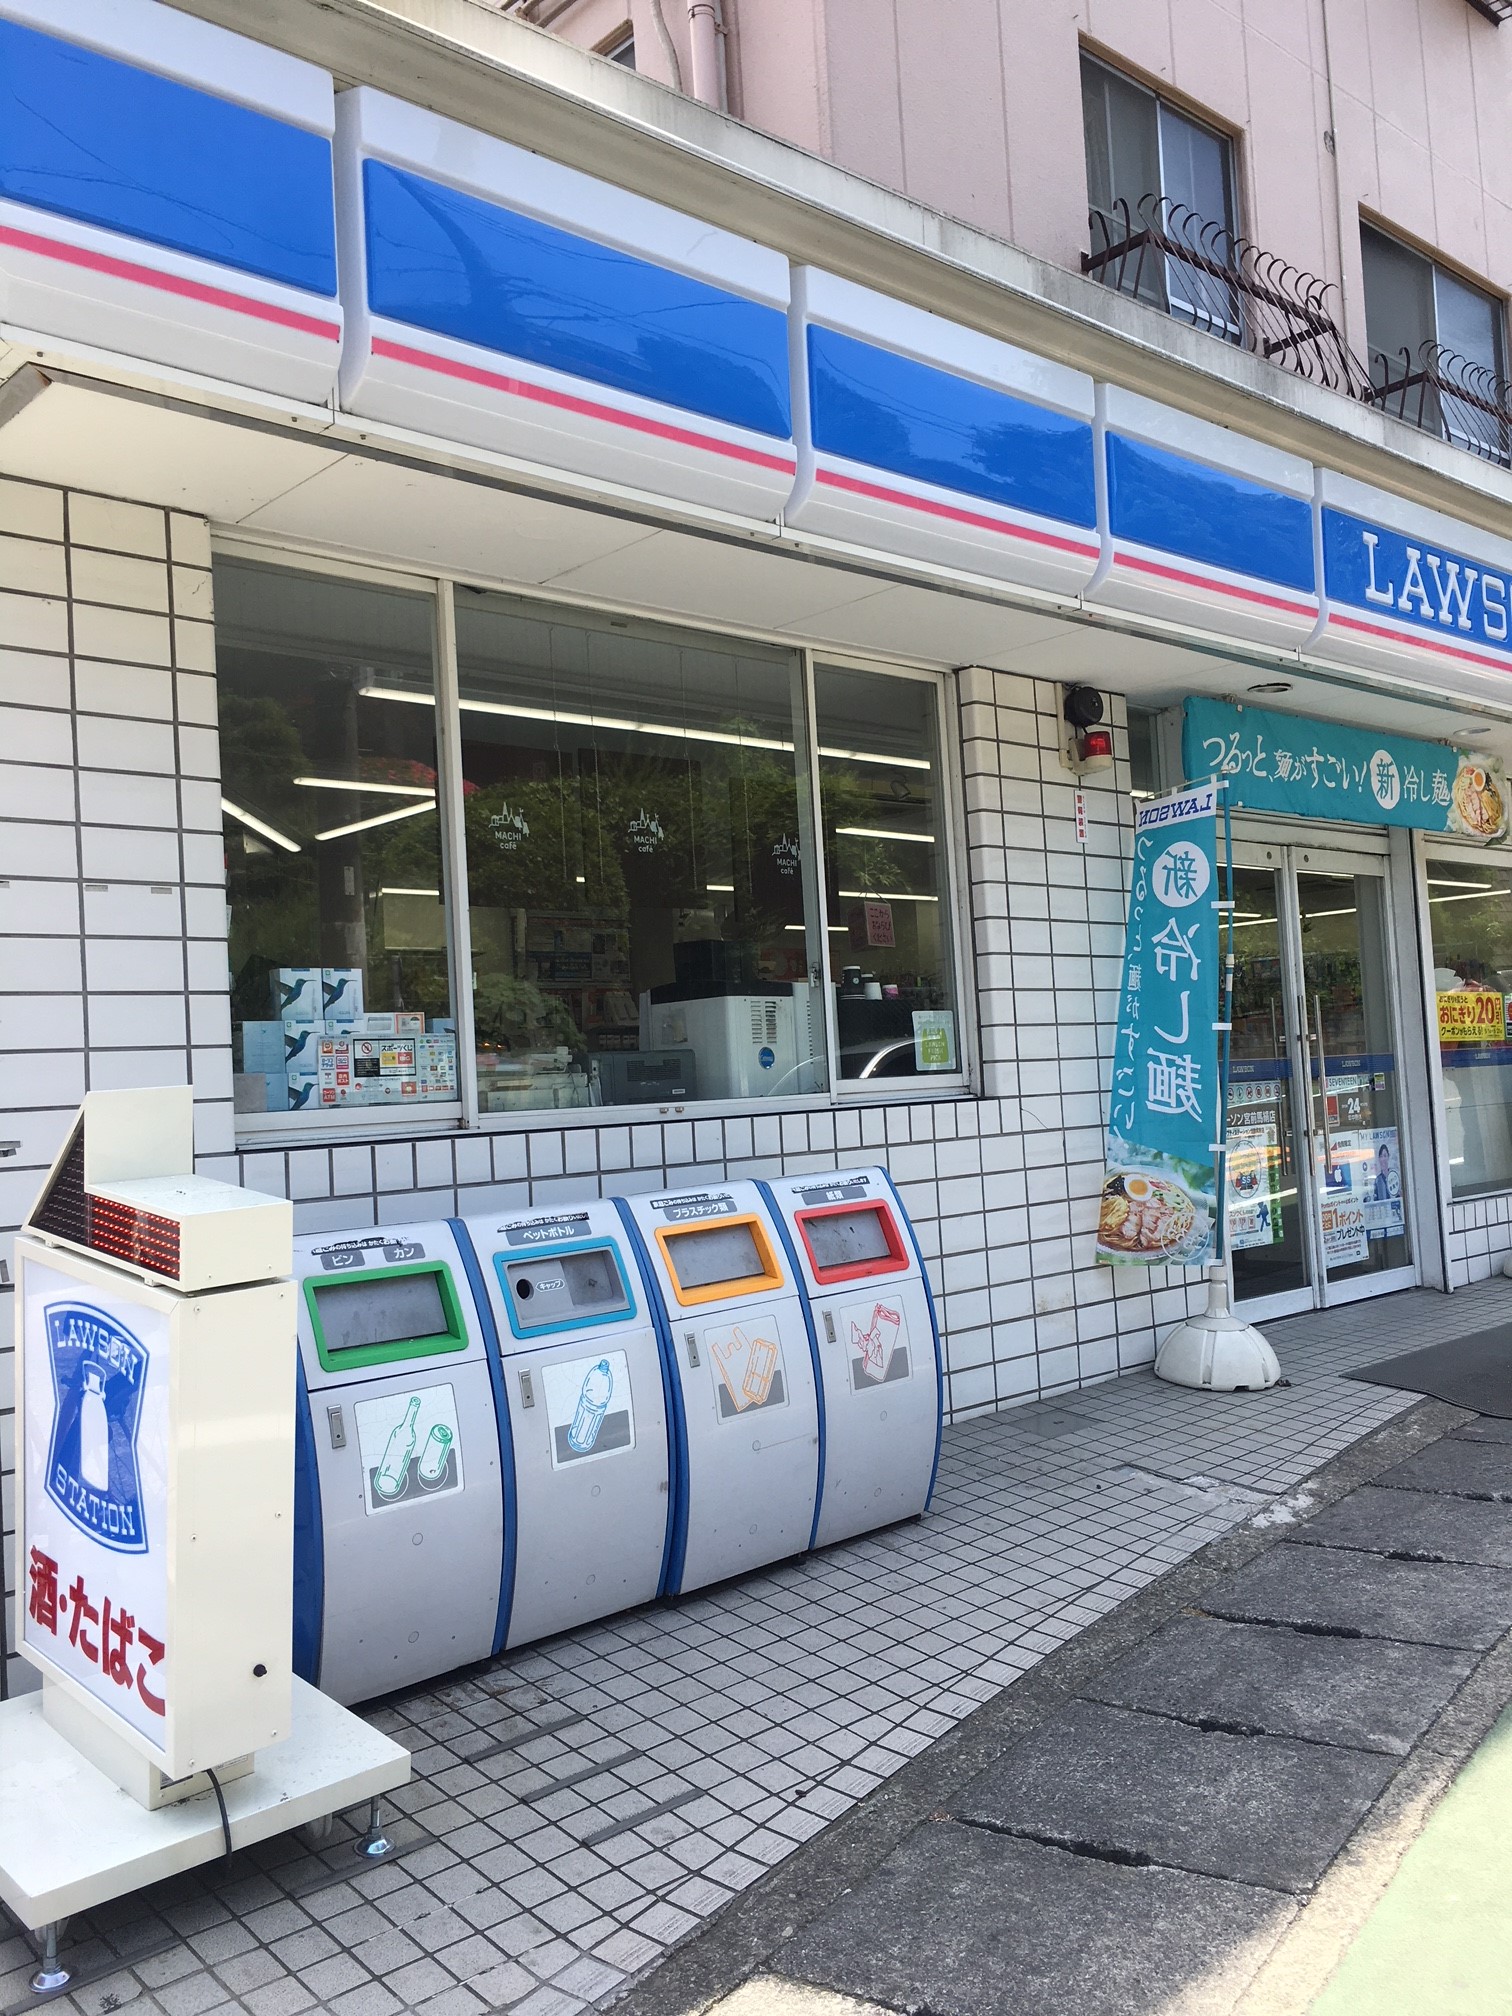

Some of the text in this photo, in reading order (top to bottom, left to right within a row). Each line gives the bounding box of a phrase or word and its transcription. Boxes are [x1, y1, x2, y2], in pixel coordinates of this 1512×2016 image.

[1363, 531, 1512, 641] LAWS
[1376, 758, 1396, 801] 新
[1403, 766, 1451, 806] 冷し麺
[495, 830, 522, 841] MACHI
[633, 835, 658, 845] MACHI
[500, 841, 517, 850] café
[638, 845, 654, 853] café
[777, 858, 798, 867] MACHI
[780, 867, 794, 875] café
[1328, 1076, 1357, 1088] SEVENTEEN
[1347, 1097, 1360, 1114] 24
[826, 1190, 843, 1201] 紙類
[673, 1202, 729, 1218] プラスチック類
[523, 1225, 575, 1240] ペットボトル
[394, 1247, 415, 1259] カン
[332, 1254, 354, 1266] ビン
[539, 1281, 561, 1290] キャップ
[54, 1318, 137, 1387] LAWSON
[55, 1462, 136, 1537] STATION
